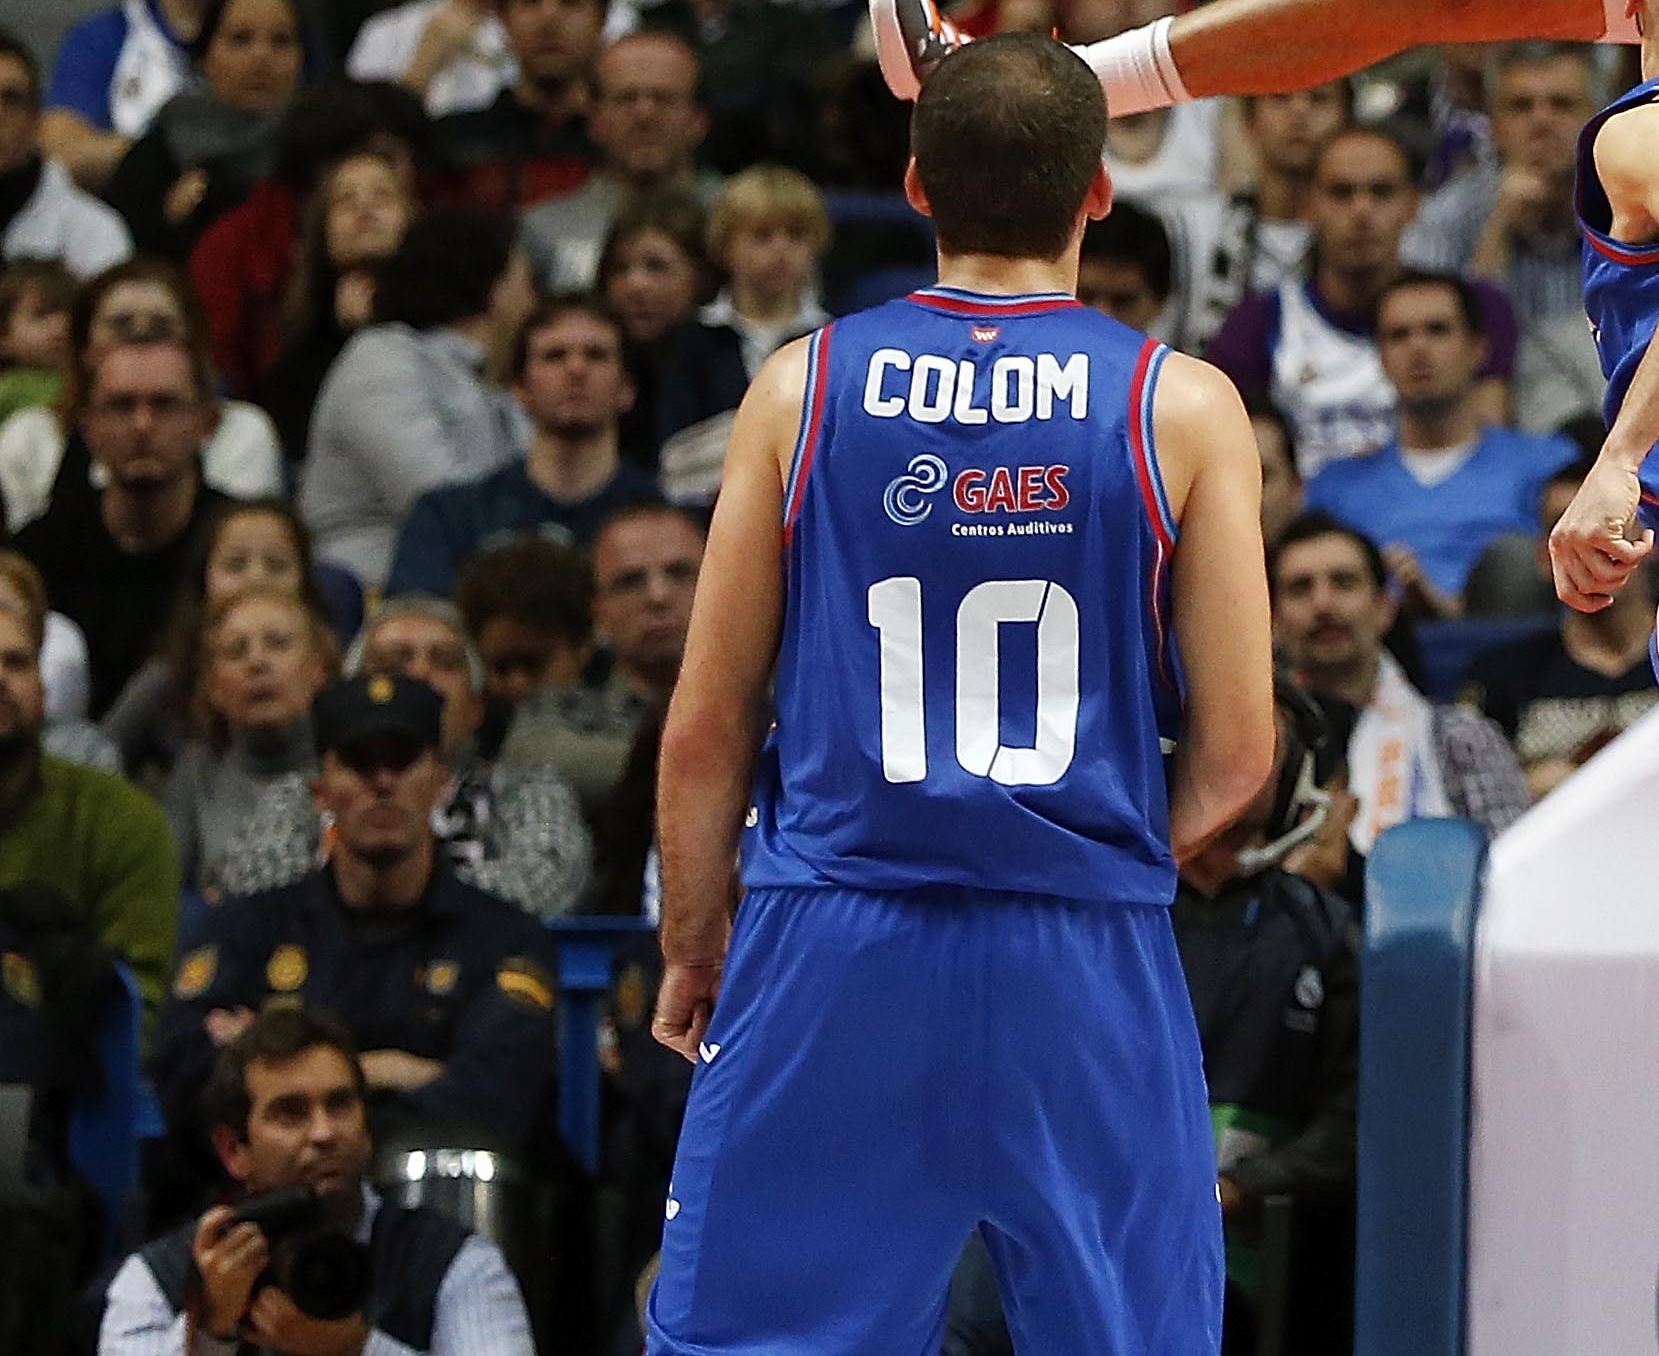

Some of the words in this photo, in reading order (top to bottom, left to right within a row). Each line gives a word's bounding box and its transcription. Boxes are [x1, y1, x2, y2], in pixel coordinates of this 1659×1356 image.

[863, 347, 1090, 425] COLOM
[953, 464, 1070, 513] GAES
[951, 523, 1004, 537] Centros
[1006, 520, 1074, 536] Auditivos
[867, 576, 1079, 786] 10
